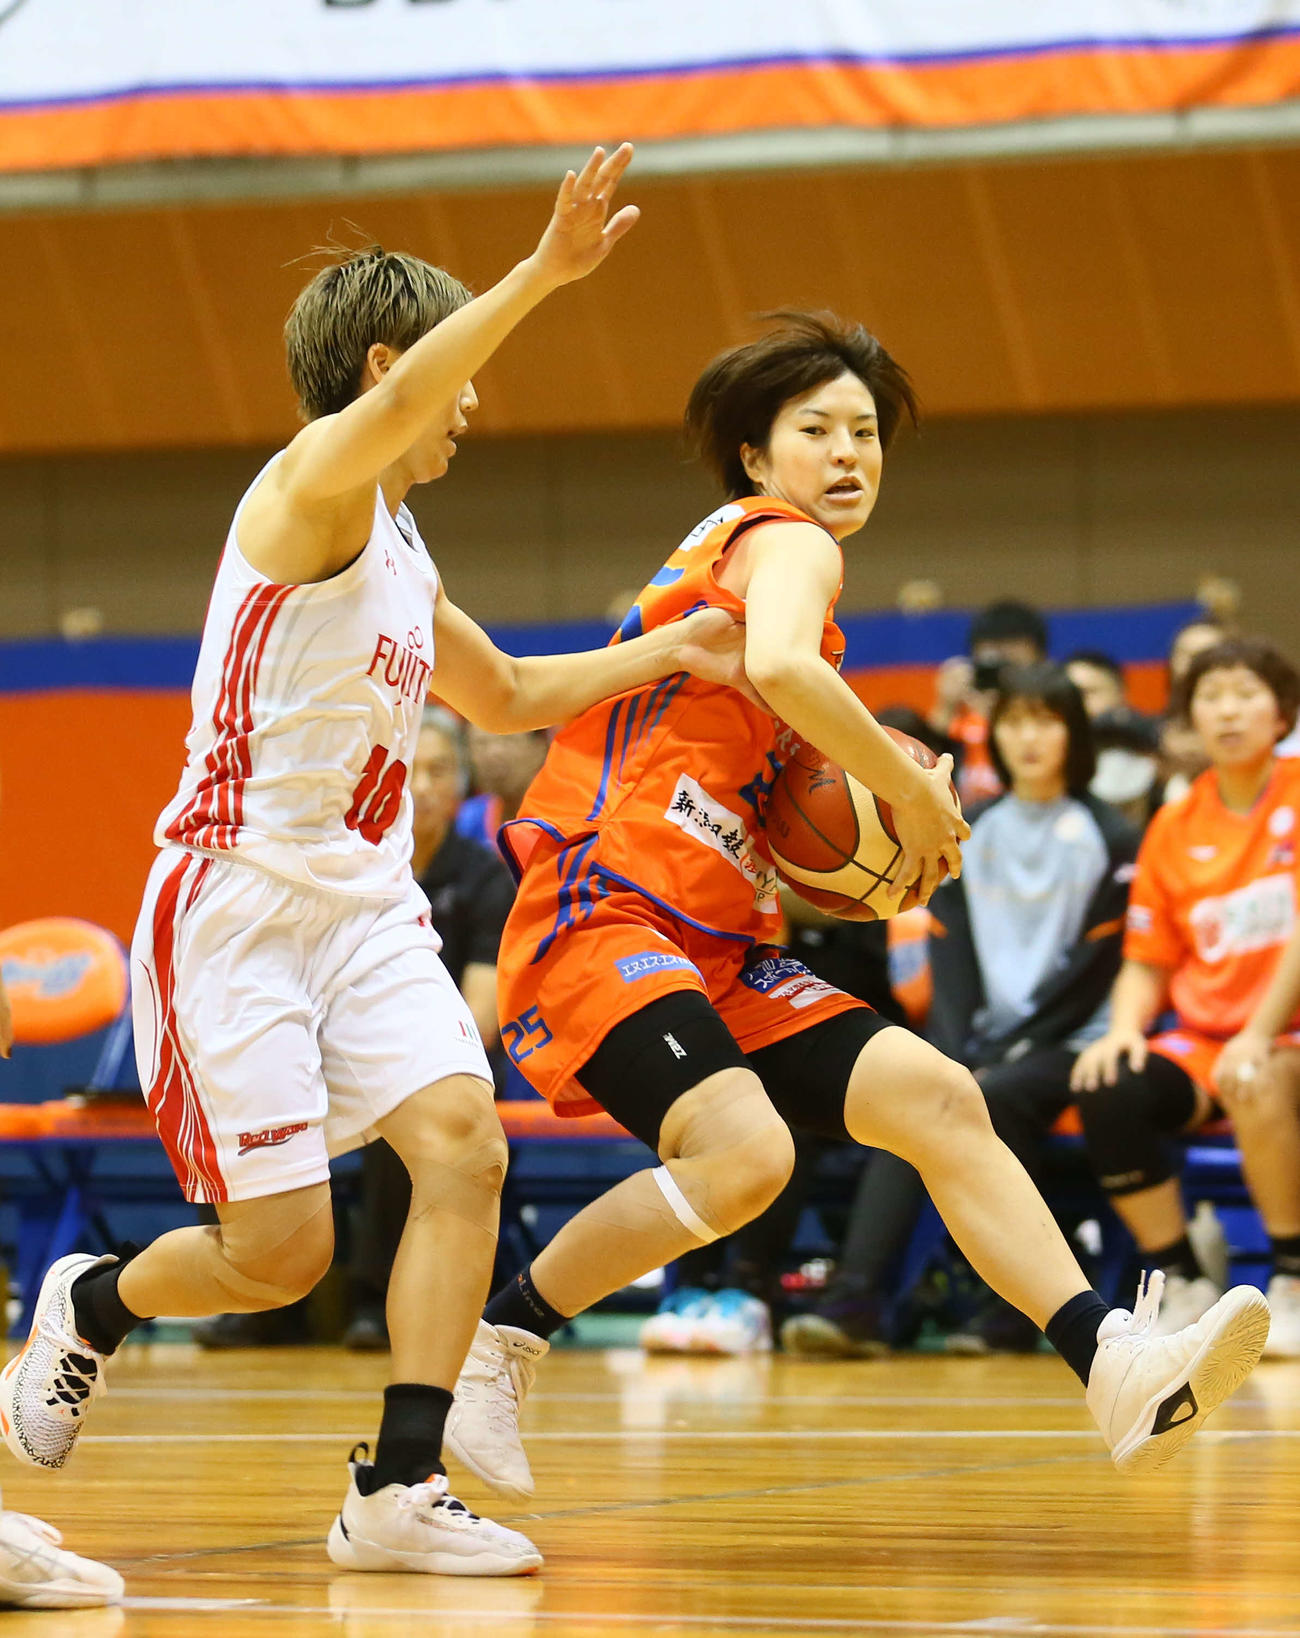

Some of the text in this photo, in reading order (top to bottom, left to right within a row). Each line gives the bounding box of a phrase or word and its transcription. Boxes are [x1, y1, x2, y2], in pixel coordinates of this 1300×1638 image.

[366, 633, 433, 706] FUJIT
[344, 743, 407, 846] 10
[501, 1004, 553, 1064] 25
